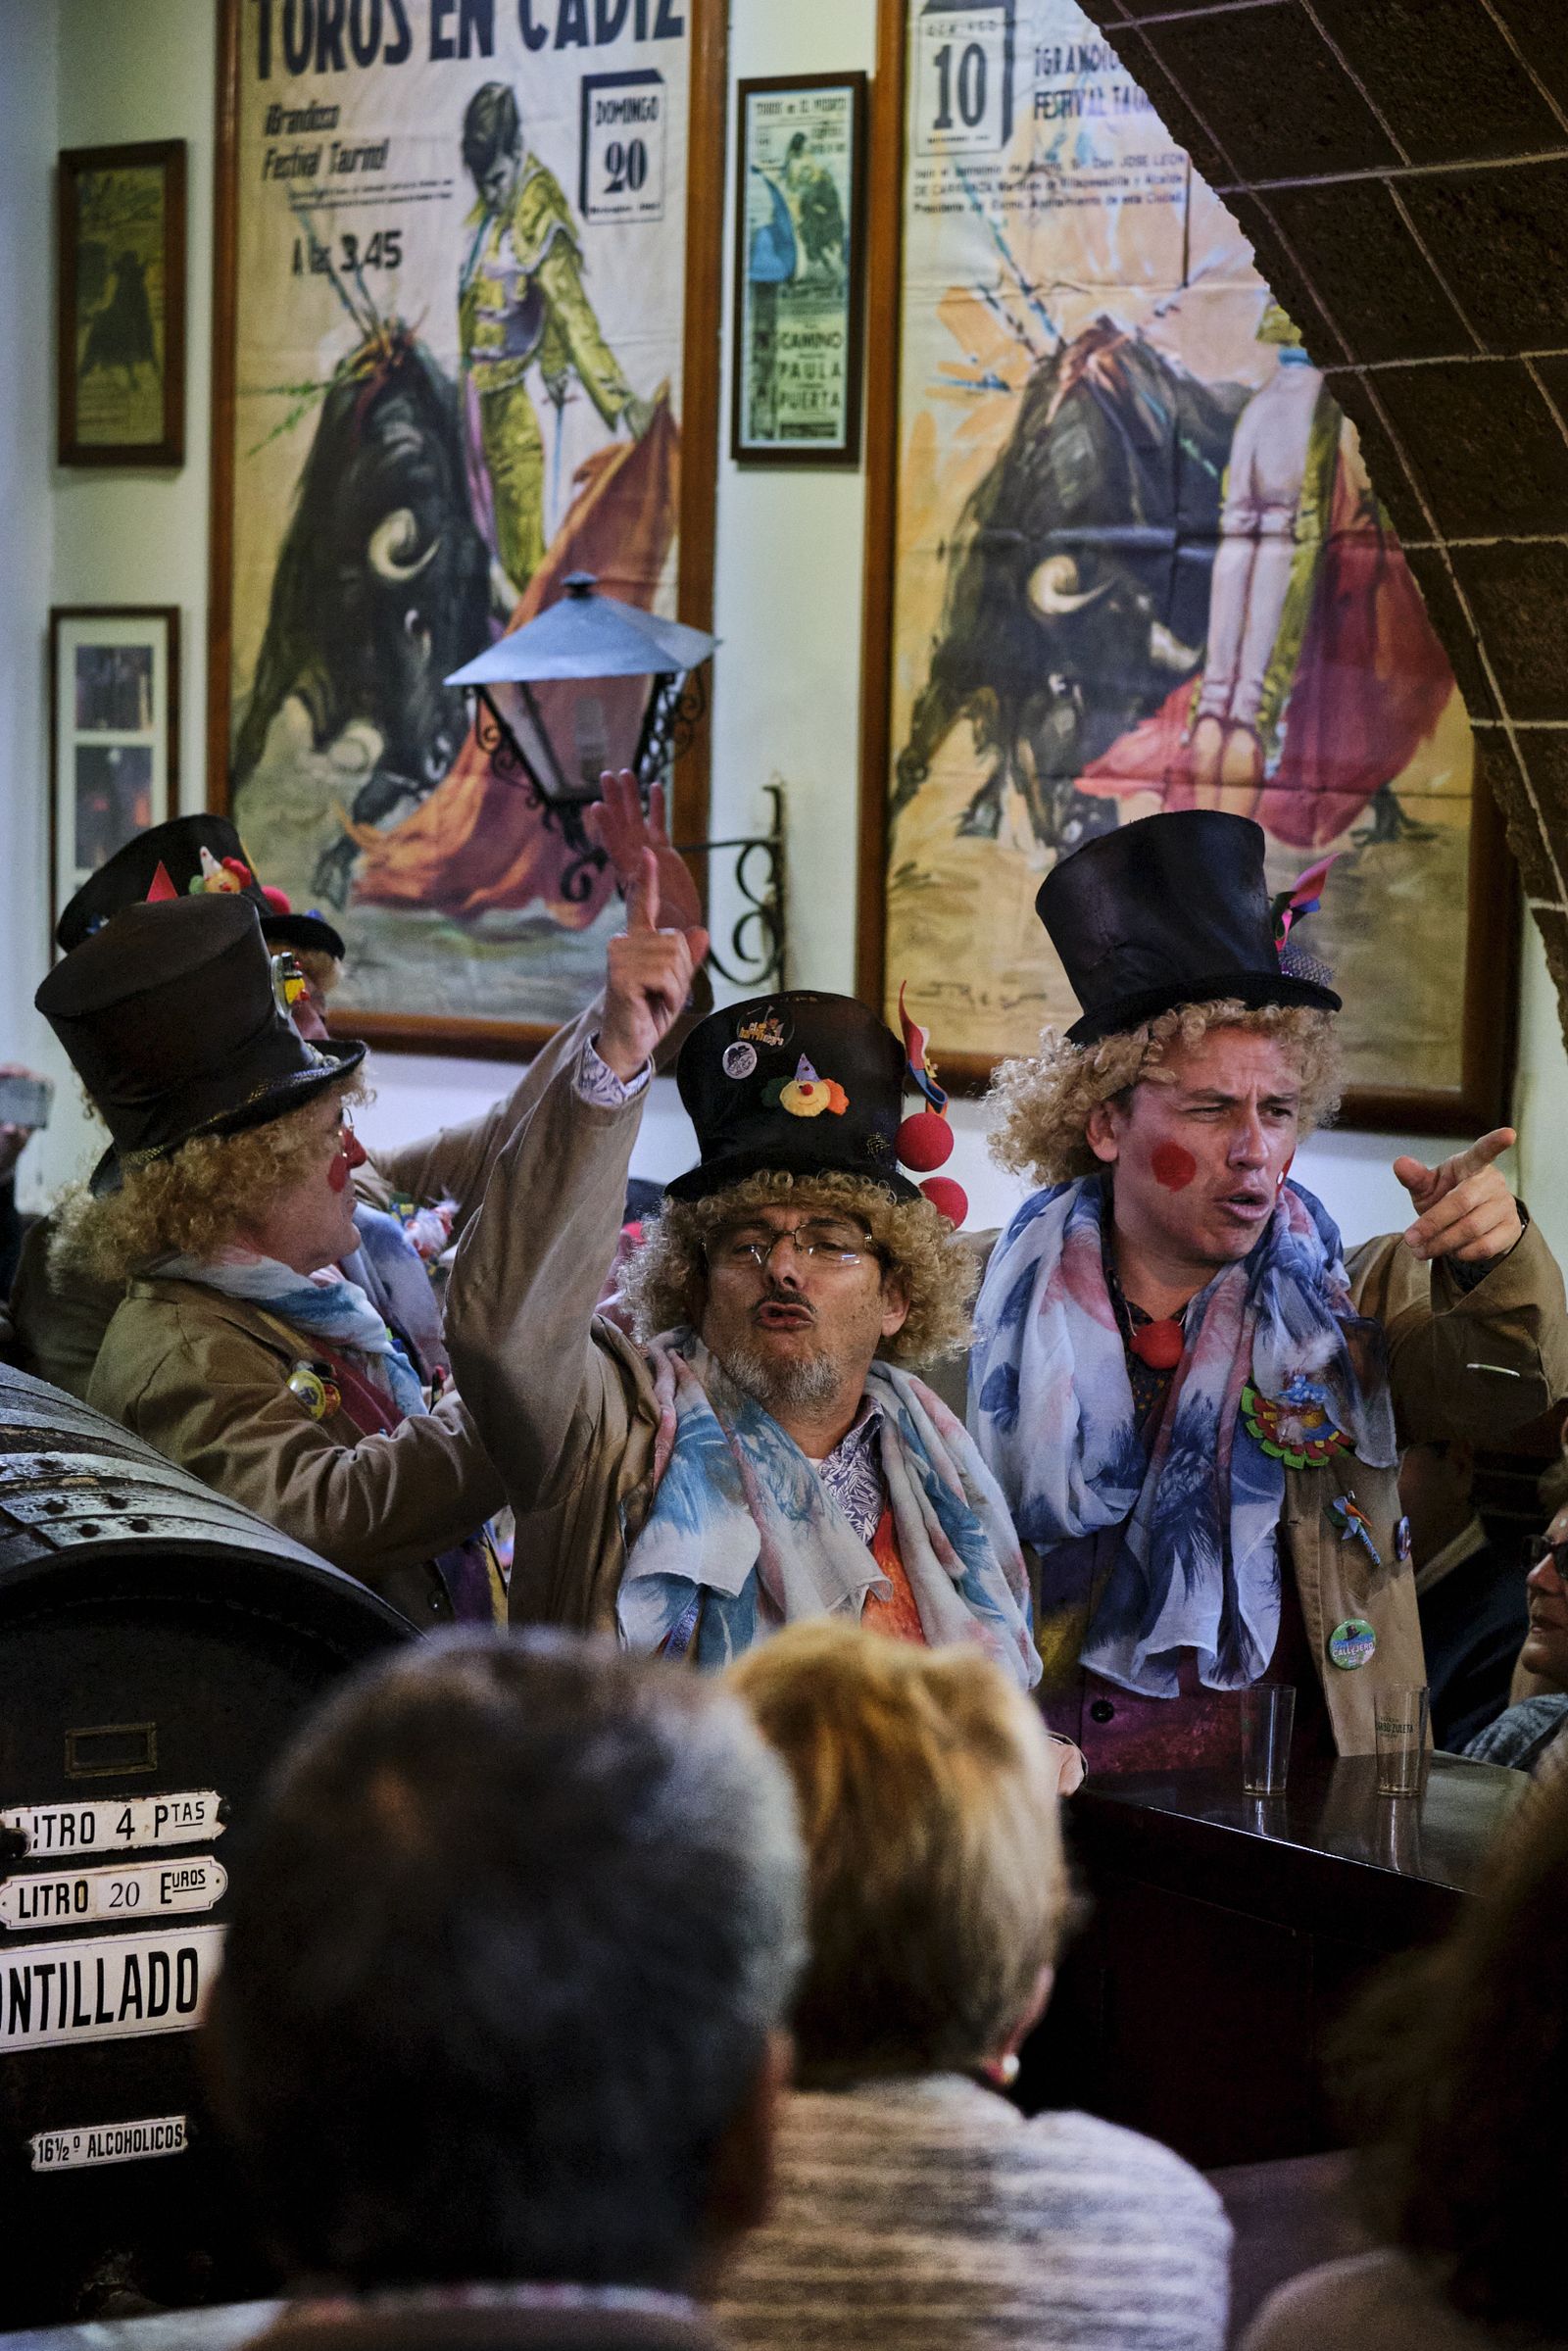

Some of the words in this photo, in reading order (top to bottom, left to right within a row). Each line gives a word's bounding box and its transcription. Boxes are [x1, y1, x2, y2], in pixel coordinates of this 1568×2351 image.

[429, 0, 495, 61] EN
[932, 42, 988, 130] 10
[595, 96, 660, 126] DOMINGO
[603, 137, 648, 194] 20
[779, 362, 842, 380] PAULA
[116, 1807, 135, 1841] 4
[19, 1880, 89, 1919] LITRO
[109, 1882, 141, 1909] 20
[0, 1947, 199, 2035] NTILLADO
[87, 2123, 184, 2159] ALCOHOLICOS
